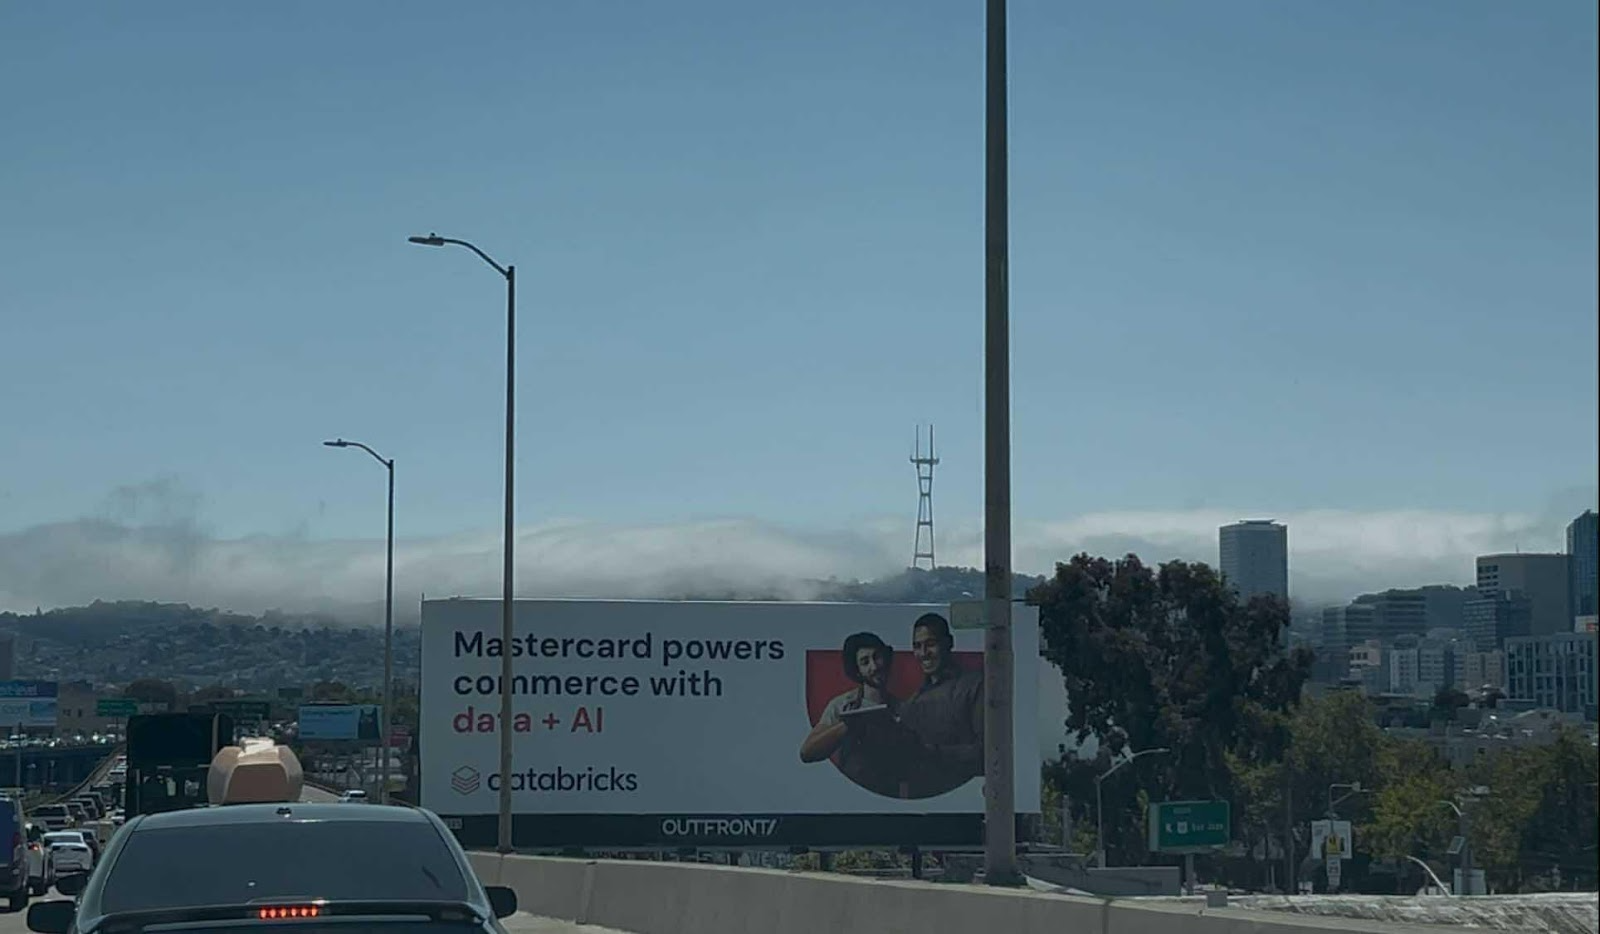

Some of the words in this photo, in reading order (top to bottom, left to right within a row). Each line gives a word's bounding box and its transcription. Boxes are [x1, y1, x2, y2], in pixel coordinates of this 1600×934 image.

[454, 630, 652, 659] Mastercard
[663, 639, 785, 666] powers
[453, 675, 640, 696] commerce
[649, 669, 722, 697] with
[453, 705, 532, 733] daa
[570, 706, 603, 733] AI
